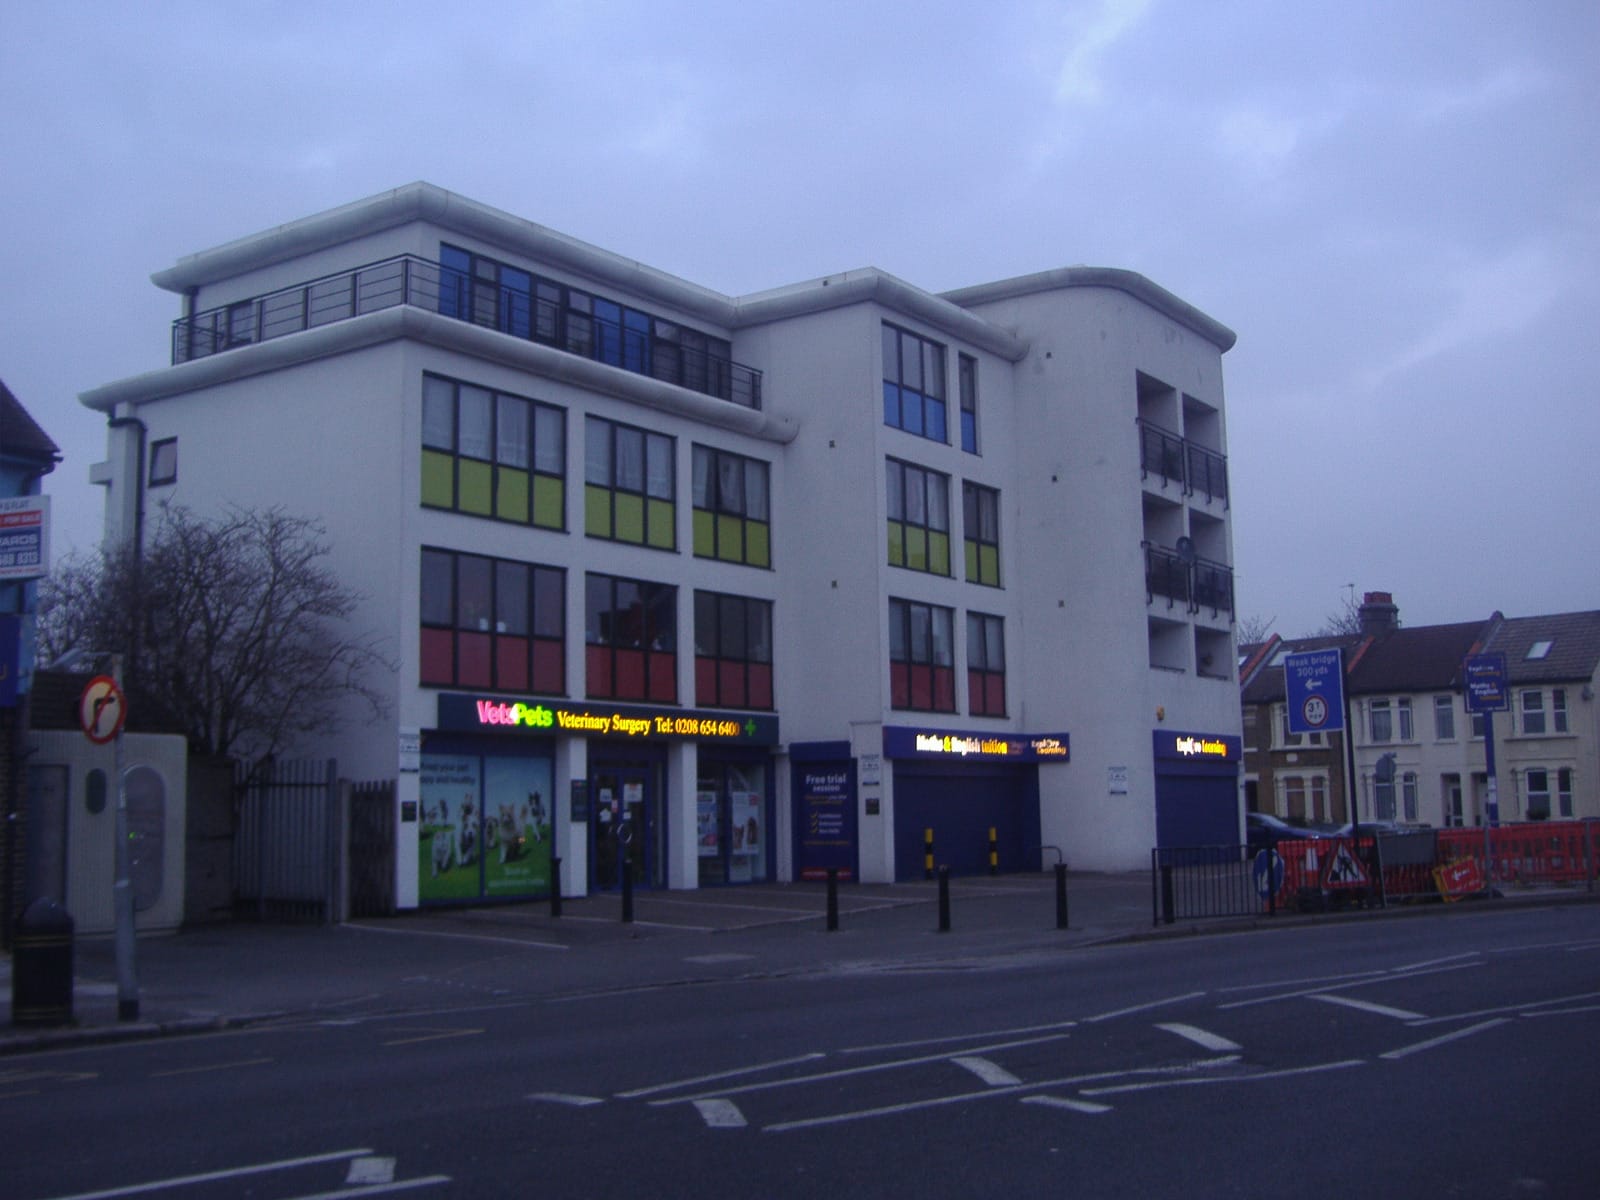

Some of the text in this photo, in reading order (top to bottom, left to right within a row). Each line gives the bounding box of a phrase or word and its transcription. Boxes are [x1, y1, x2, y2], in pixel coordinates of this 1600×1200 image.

[1288, 654, 1336, 667] Weak bridge
[1315, 665, 1329, 677] yds
[557, 711, 740, 736] Veterinary Surgery Tel: 0208 654 6400
[943, 736, 951, 752] &
[951, 736, 980, 756] English
[981, 738, 1006, 755] tuition
[806, 773, 847, 785] Free trial
[813, 785, 841, 793] session
